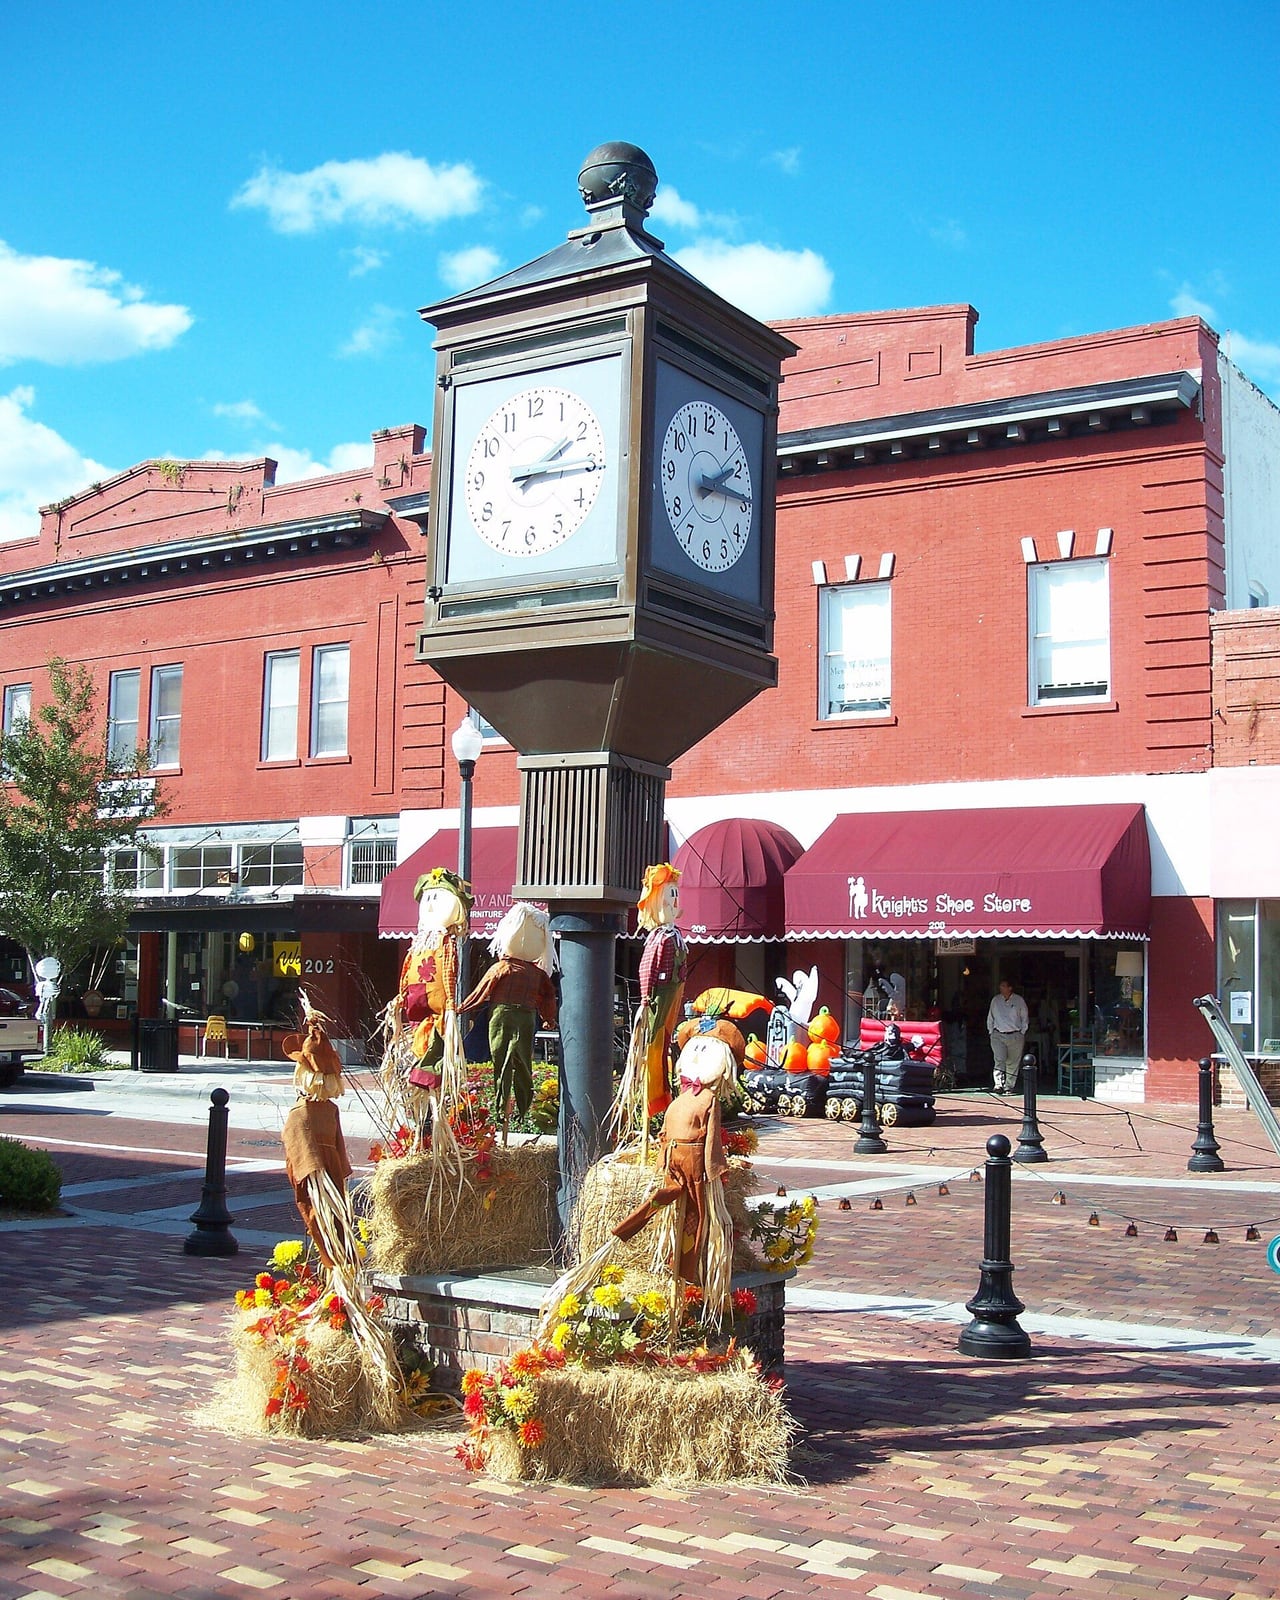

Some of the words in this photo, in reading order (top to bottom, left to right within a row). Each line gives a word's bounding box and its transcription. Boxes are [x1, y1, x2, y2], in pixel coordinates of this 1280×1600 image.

[527, 397, 544, 418] 12
[559, 402, 564, 421] 1
[504, 412, 516, 433] 11
[576, 421, 588, 441] 2
[688, 414, 697, 437] 11
[704, 411, 716, 435] 12
[484, 437, 500, 458] 10
[674, 429, 686, 453] 10
[724, 431, 728, 451] 1
[667, 460, 675, 480] 9
[734, 459, 742, 479] 2
[474, 471, 485, 491] 9
[573, 488, 585, 508] 4
[673, 496, 682, 517] 8
[482, 502, 493, 522] 8
[502, 520, 512, 540] 7
[552, 513, 563, 534] 5
[732, 523, 741, 543] 4
[524, 525, 536, 546] 6
[686, 524, 695, 544] 7
[703, 540, 711, 560] 6
[720, 538, 728, 559] 5
[489, 895, 513, 907] AND
[935, 892, 975, 916] Shoe
[983, 892, 1032, 913] Store
[305, 960, 334, 973] 202
